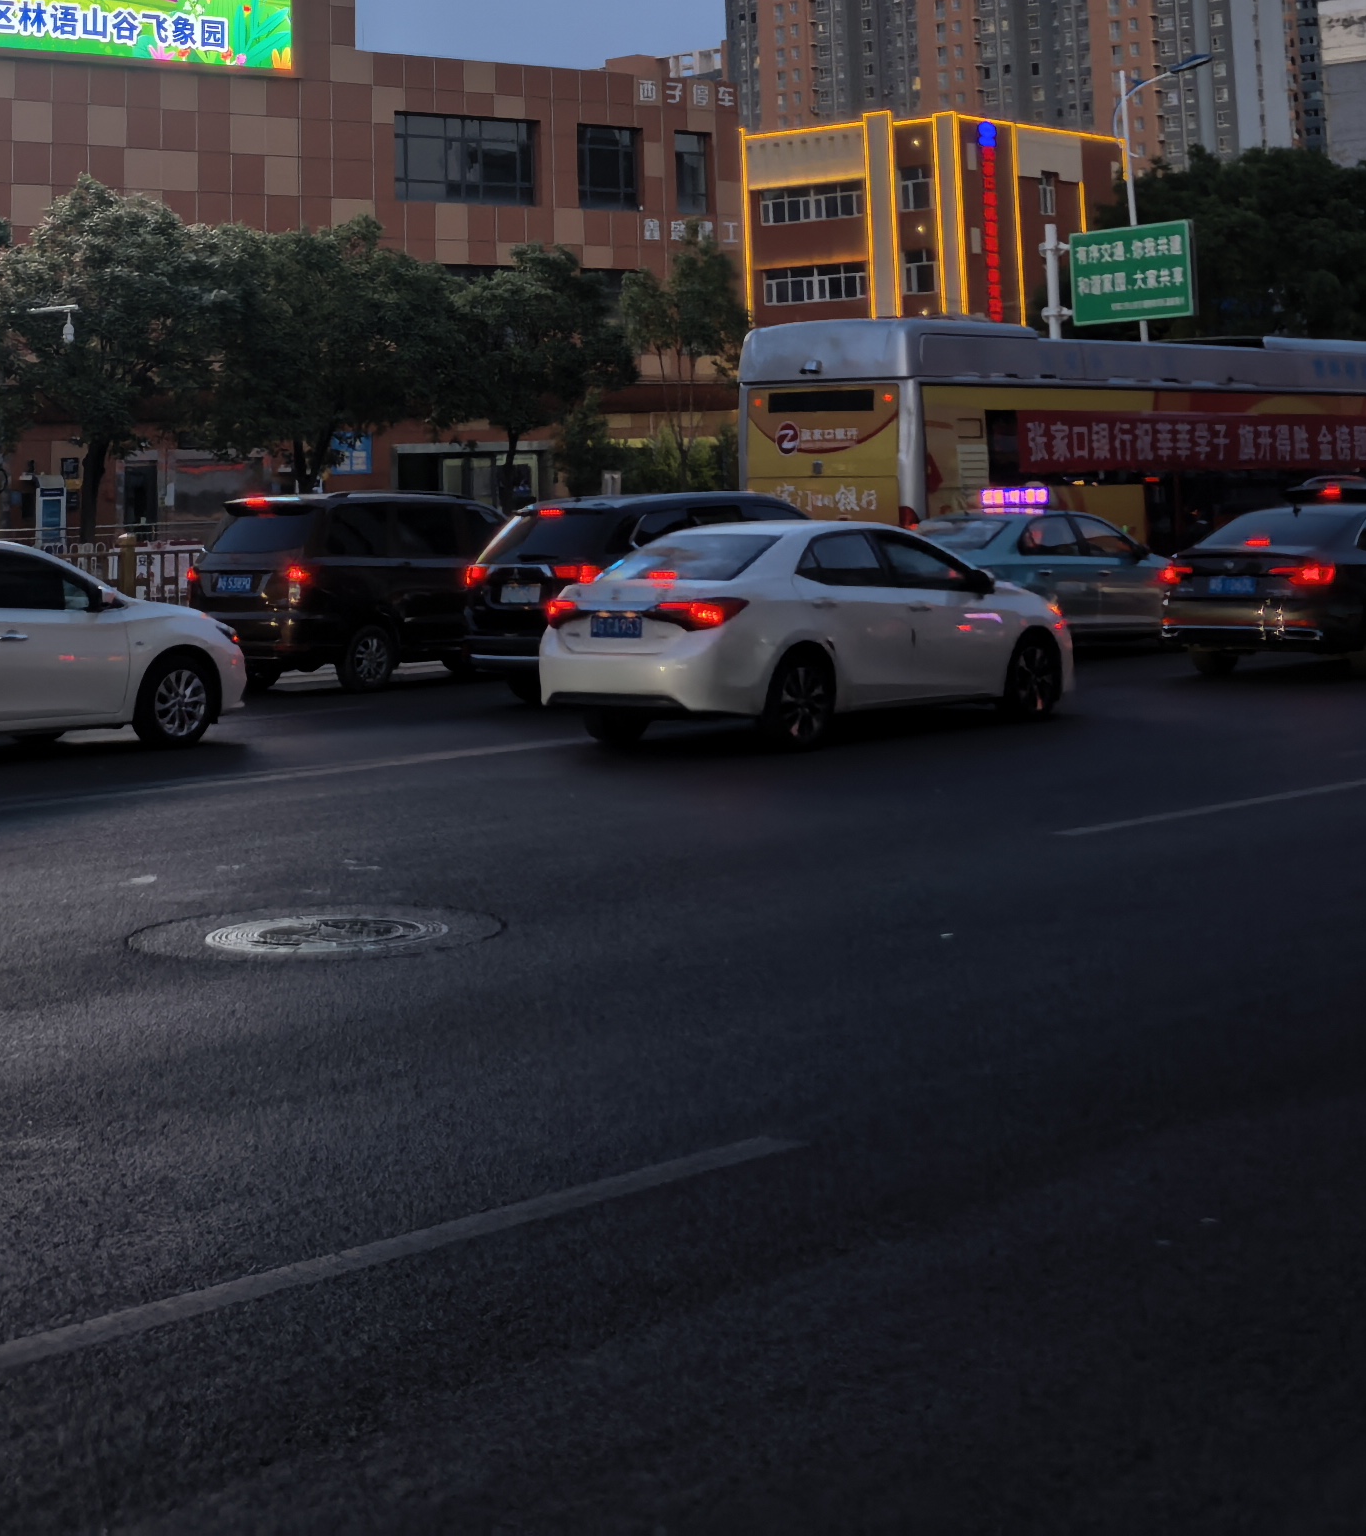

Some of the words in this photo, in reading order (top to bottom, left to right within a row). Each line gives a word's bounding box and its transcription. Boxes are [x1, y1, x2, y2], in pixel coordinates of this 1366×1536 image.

[1026, 420, 1231, 463] 张家口银行祝莘莘学子
[1238, 423, 1311, 462] 旗开得胜
